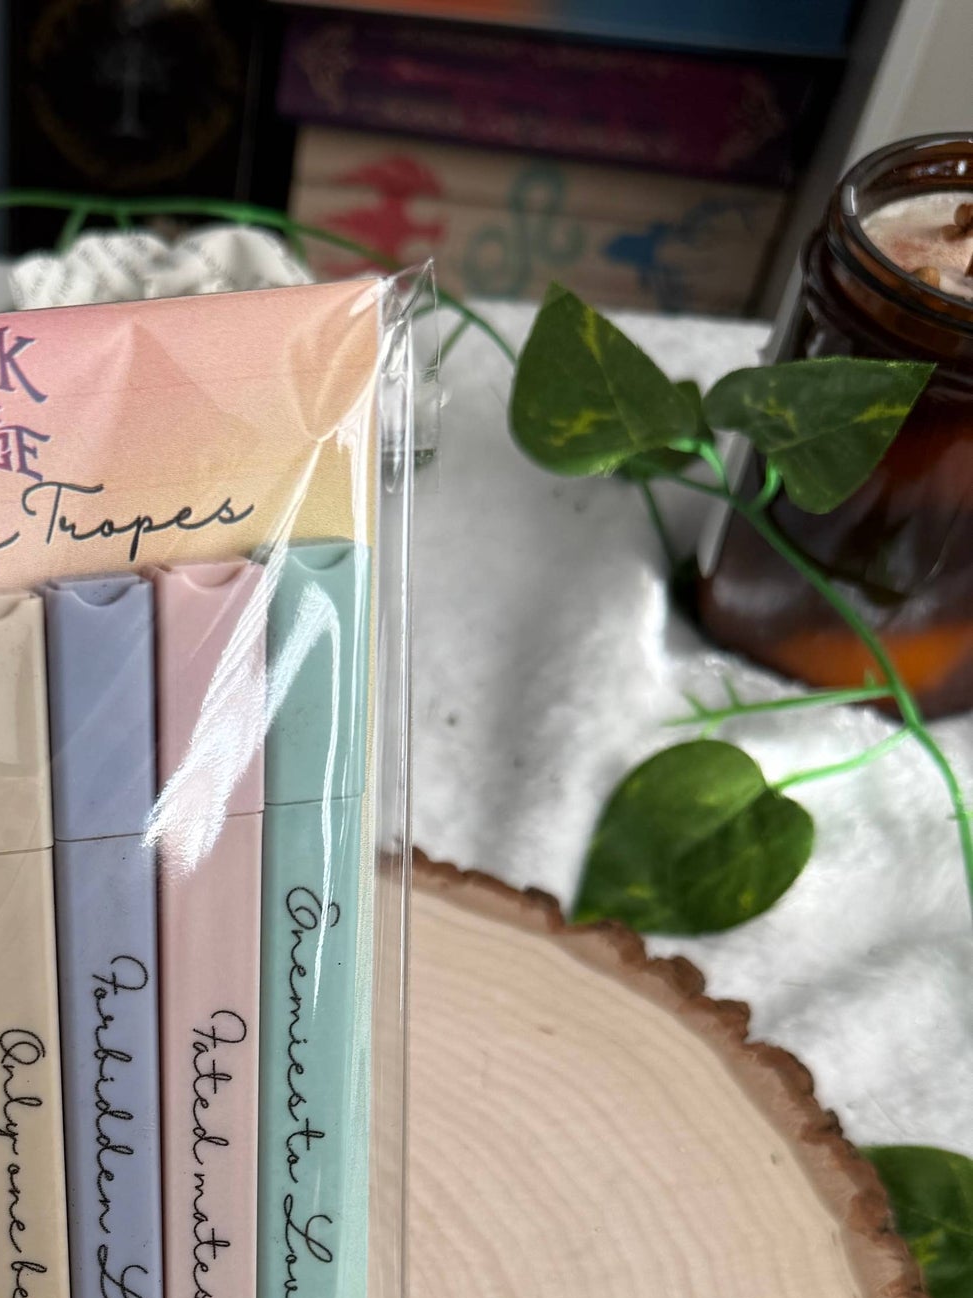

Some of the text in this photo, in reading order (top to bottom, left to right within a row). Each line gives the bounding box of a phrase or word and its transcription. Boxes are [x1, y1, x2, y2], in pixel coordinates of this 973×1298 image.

[22, 481, 255, 562] Tropes
[285, 886, 341, 1122] Enemies
[92, 955, 149, 1235] Forbidden
[193, 1010, 247, 1165] Fated
[7, 1162, 25, 1254] one
[285, 1118, 325, 1184] to
